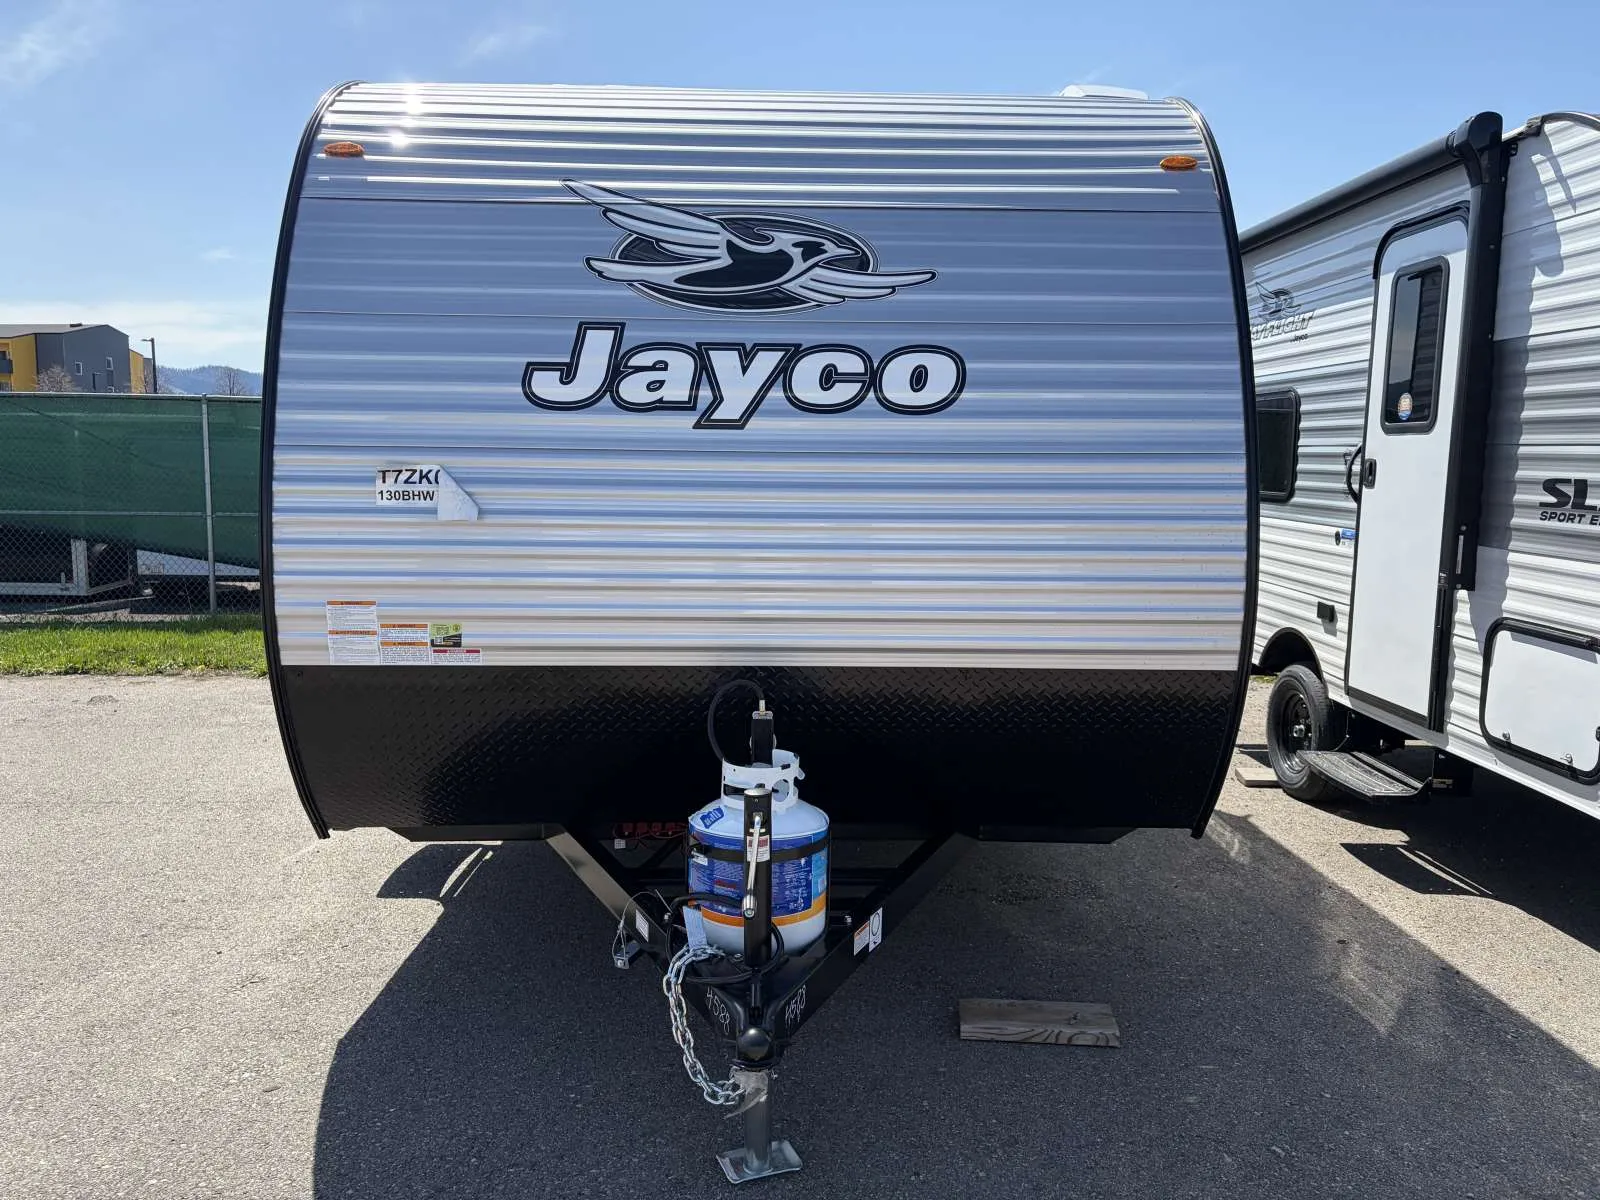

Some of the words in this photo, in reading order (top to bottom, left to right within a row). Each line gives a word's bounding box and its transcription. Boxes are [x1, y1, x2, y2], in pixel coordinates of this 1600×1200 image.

[521, 320, 967, 430] Jayco
[378, 490, 435, 502] 130BHW
[1539, 478, 1600, 511] SL
[1539, 510, 1587, 524] SPORT
